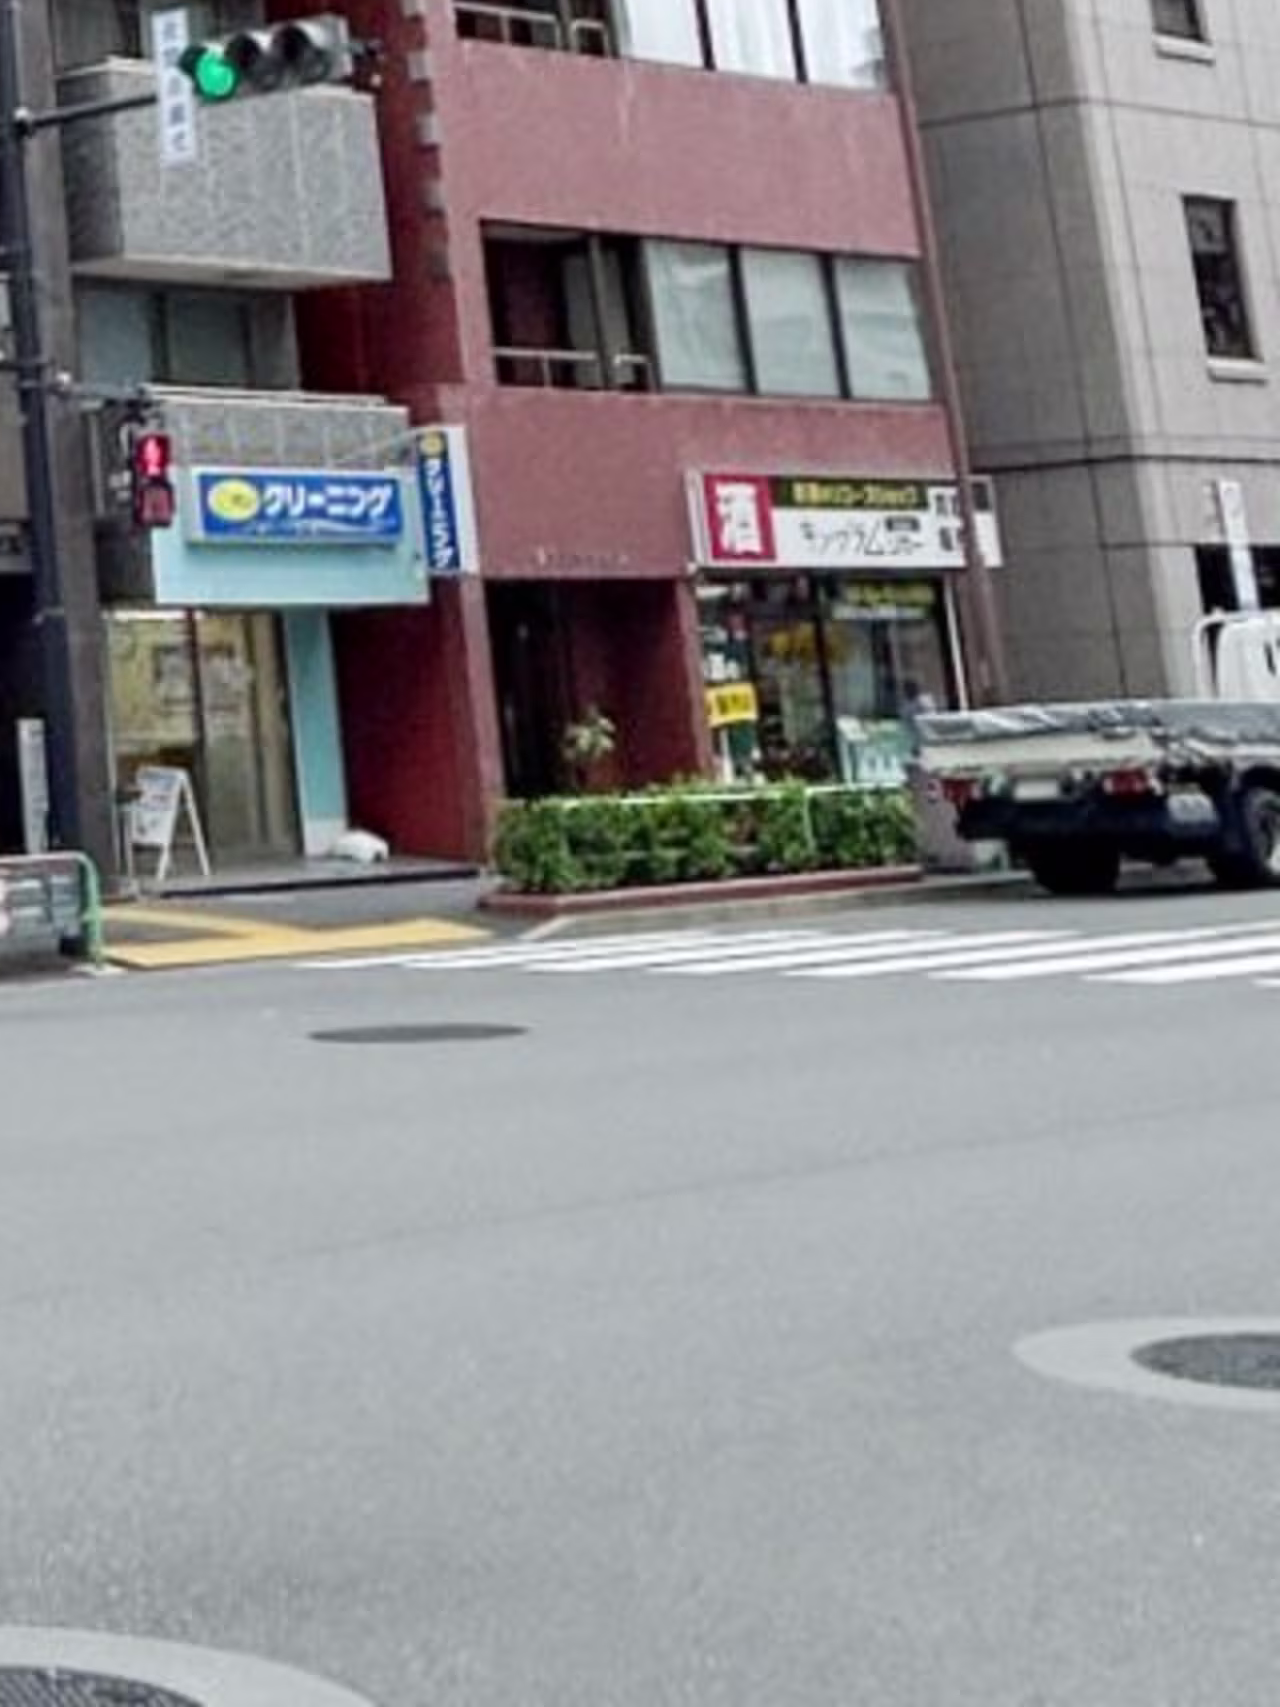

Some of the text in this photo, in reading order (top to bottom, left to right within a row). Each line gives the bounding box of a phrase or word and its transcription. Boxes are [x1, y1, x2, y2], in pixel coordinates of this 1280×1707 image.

[264, 483, 394, 519] クリーニング
